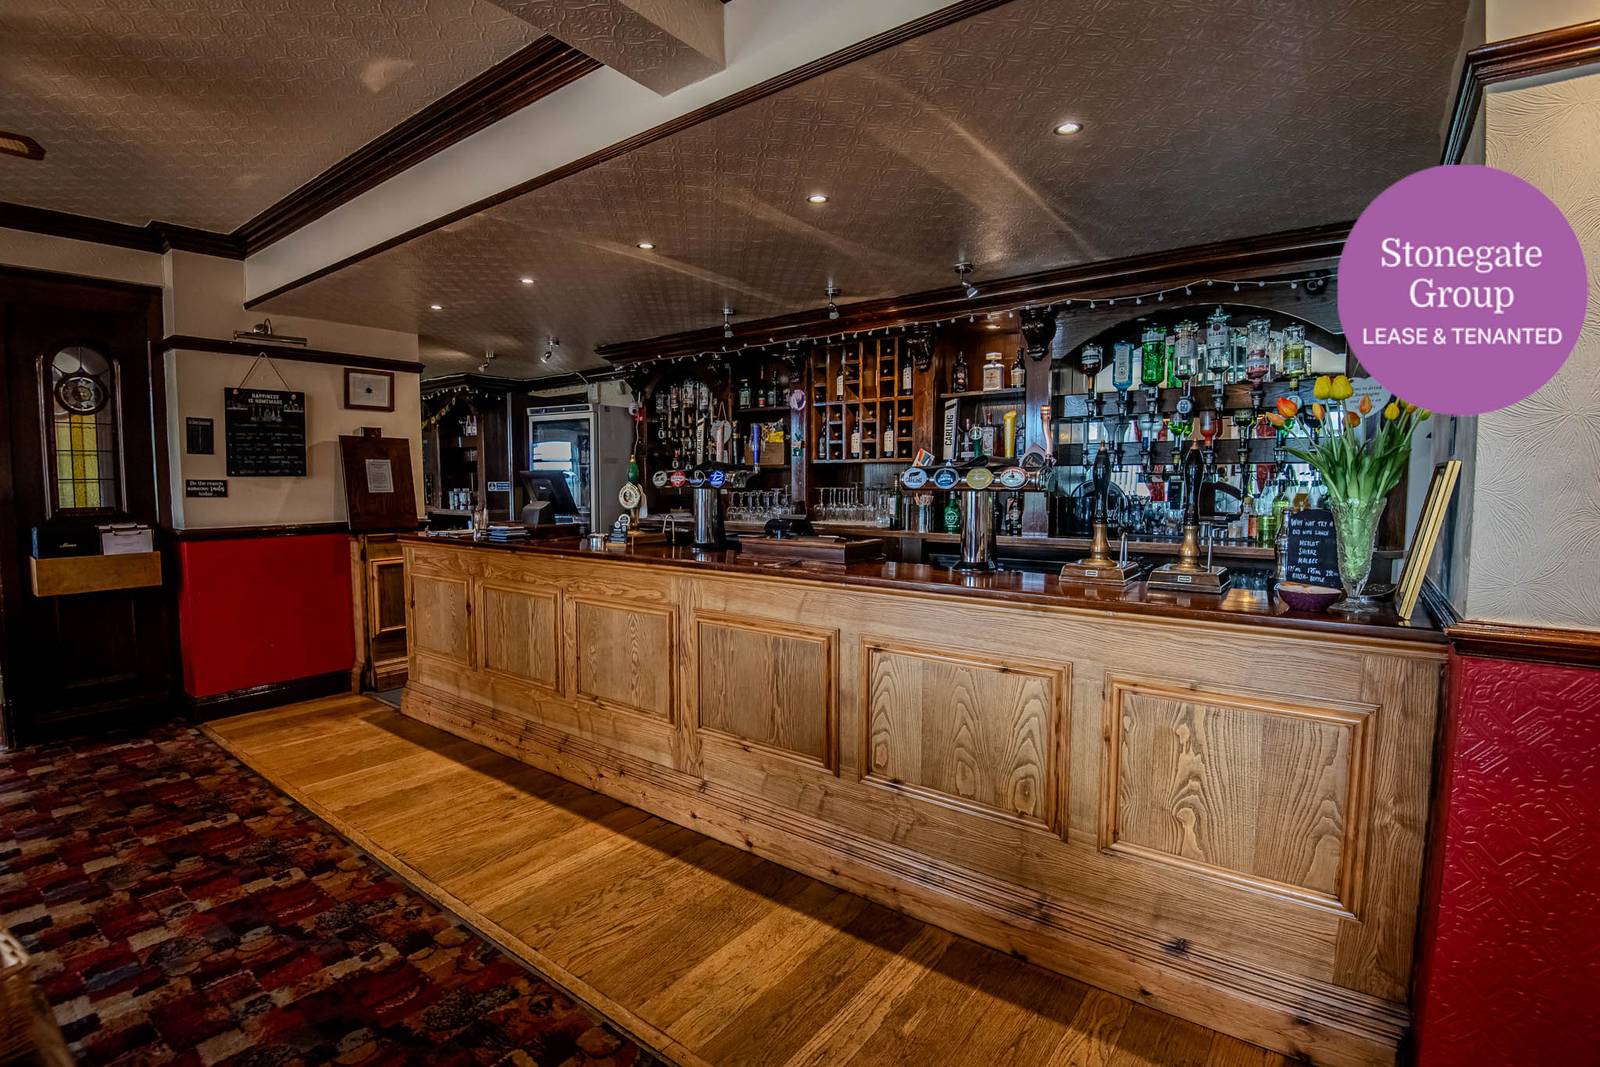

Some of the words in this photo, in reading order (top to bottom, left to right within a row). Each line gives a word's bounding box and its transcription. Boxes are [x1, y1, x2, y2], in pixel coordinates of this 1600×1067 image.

[944, 414, 954, 446] CARLING
[1290, 518, 1303, 527] WHY
[1298, 547, 1317, 555] SHIRAZ
